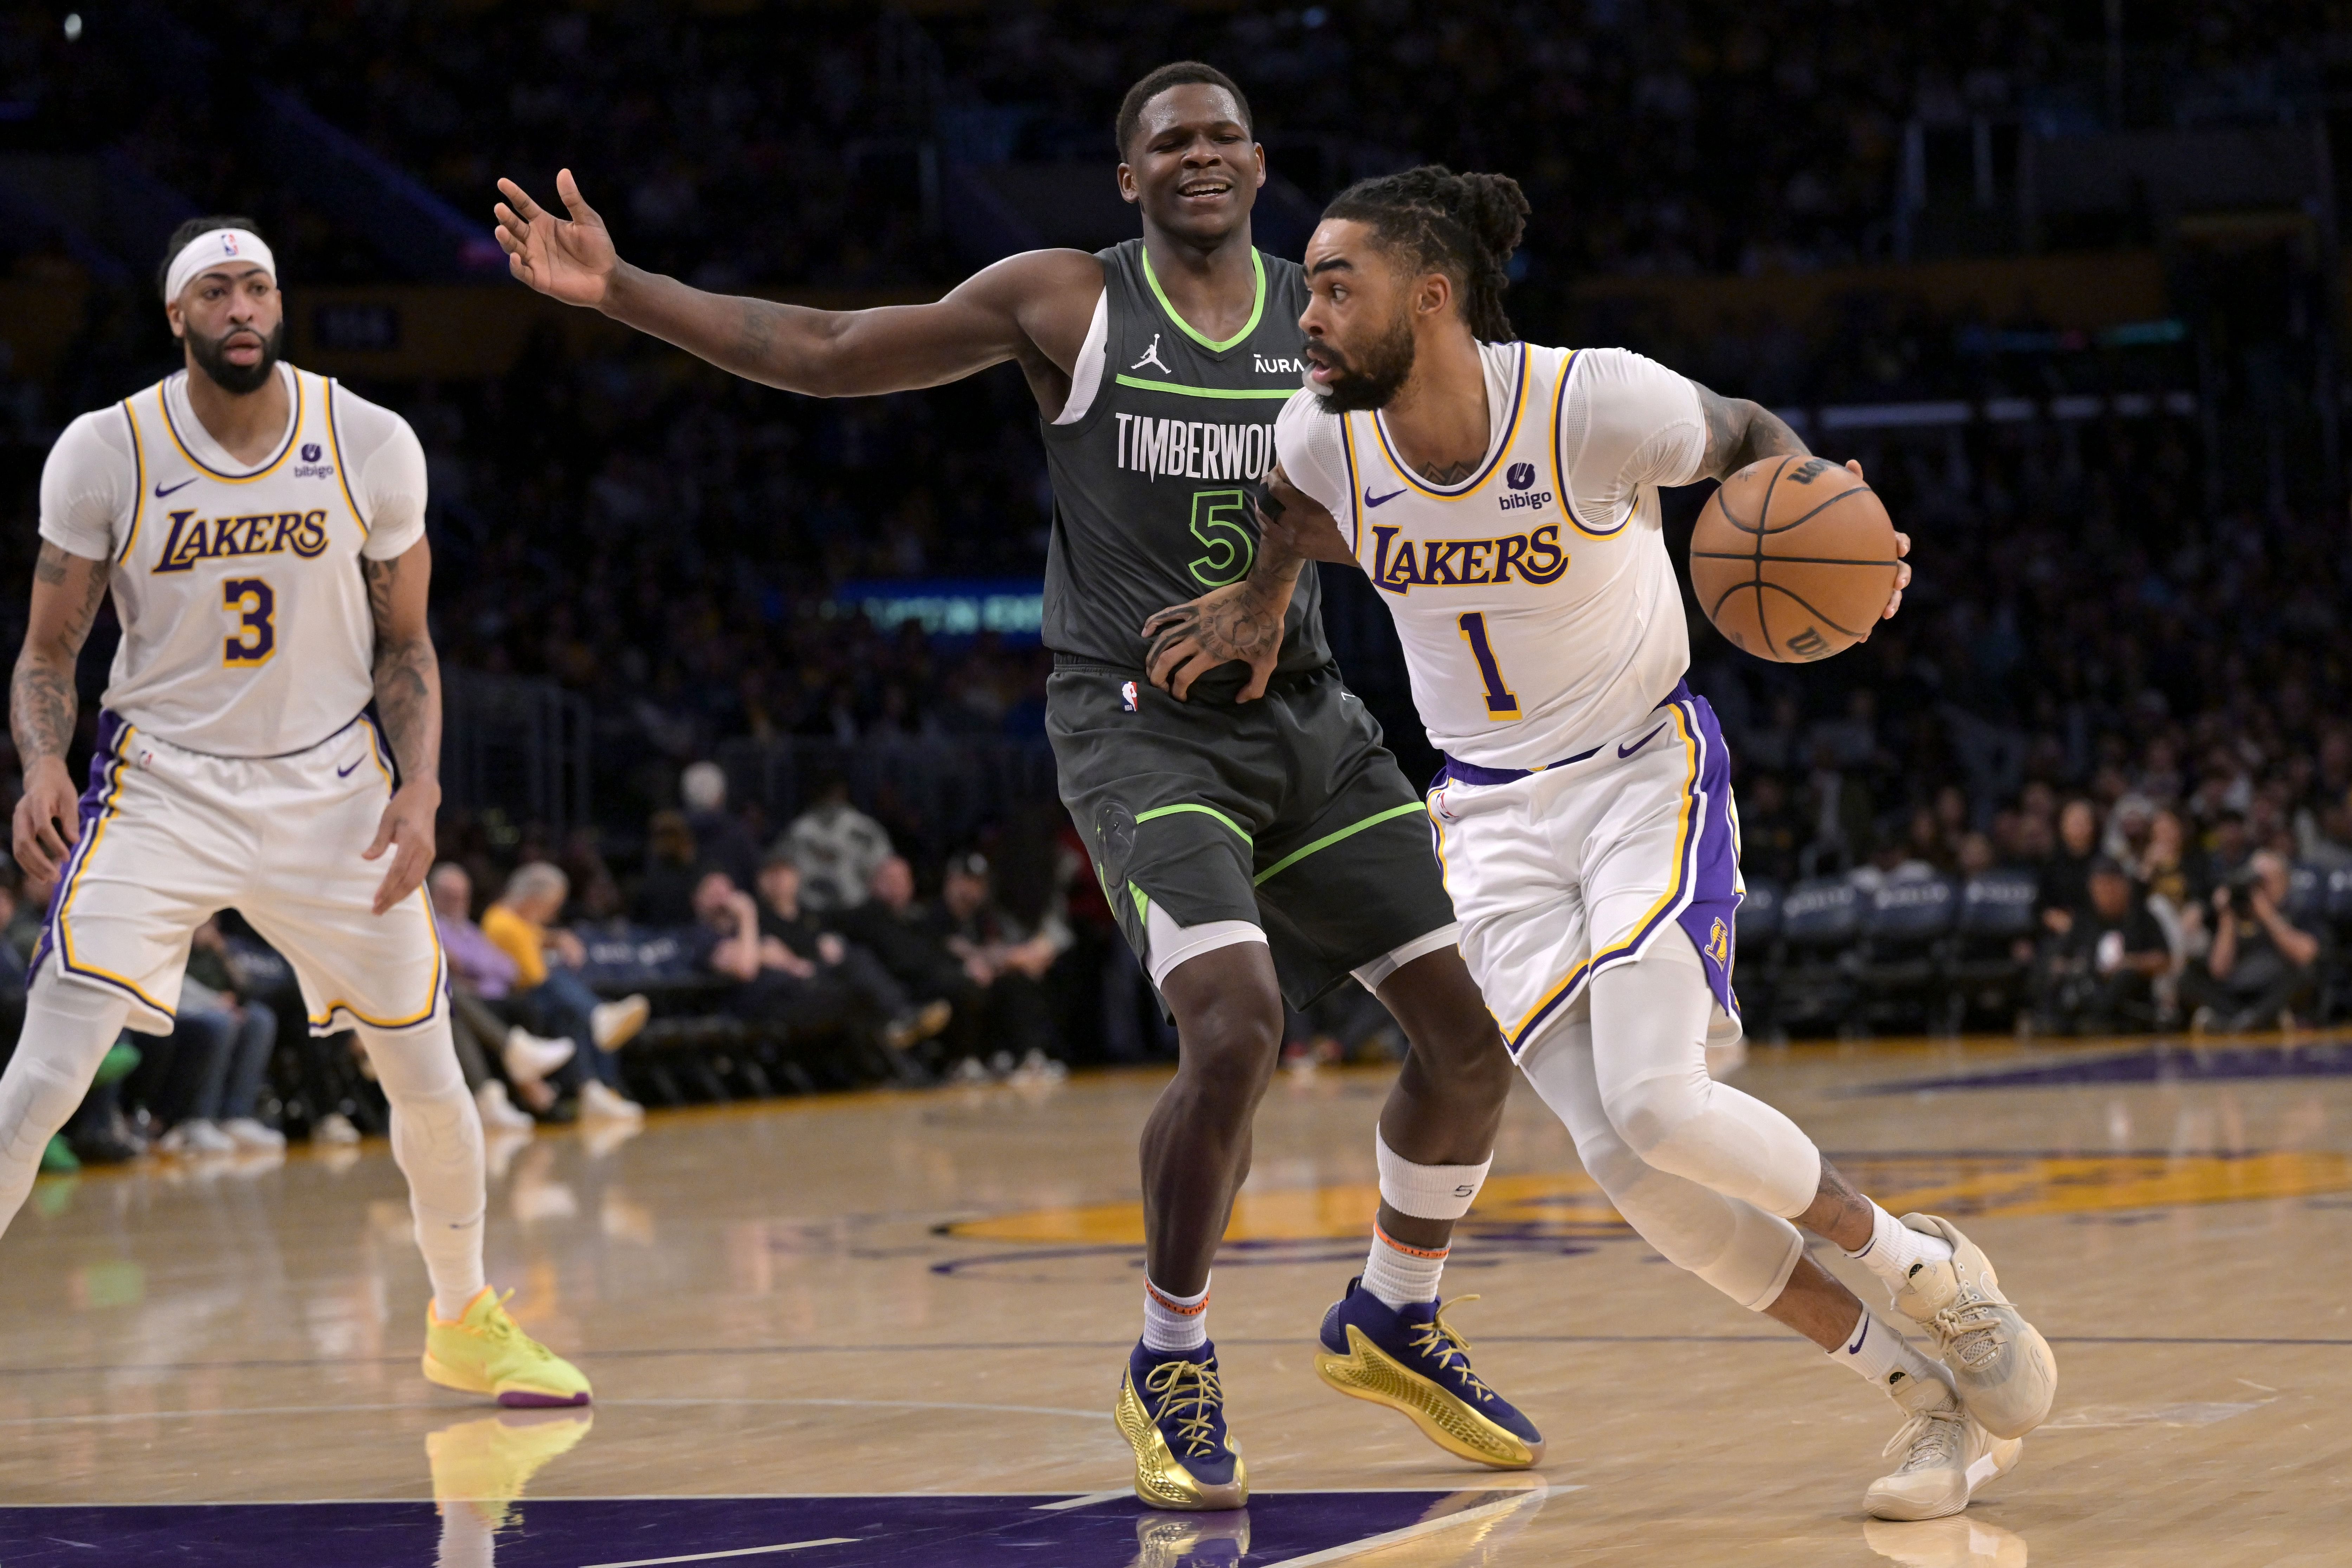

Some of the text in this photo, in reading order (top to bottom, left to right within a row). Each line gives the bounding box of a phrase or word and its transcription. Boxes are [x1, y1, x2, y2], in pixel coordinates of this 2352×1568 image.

[294, 466, 334, 480] bibigo
[1116, 413, 1279, 483] TIMBERWOL
[1499, 492, 1552, 510] bibigo
[151, 508, 329, 575] LAKERS
[1189, 489, 1253, 587] 5
[1370, 523, 1571, 597] LAKERS
[223, 576, 276, 668] 3
[1456, 611, 1523, 721] 1
[1454, 1184, 1474, 1198] 5
